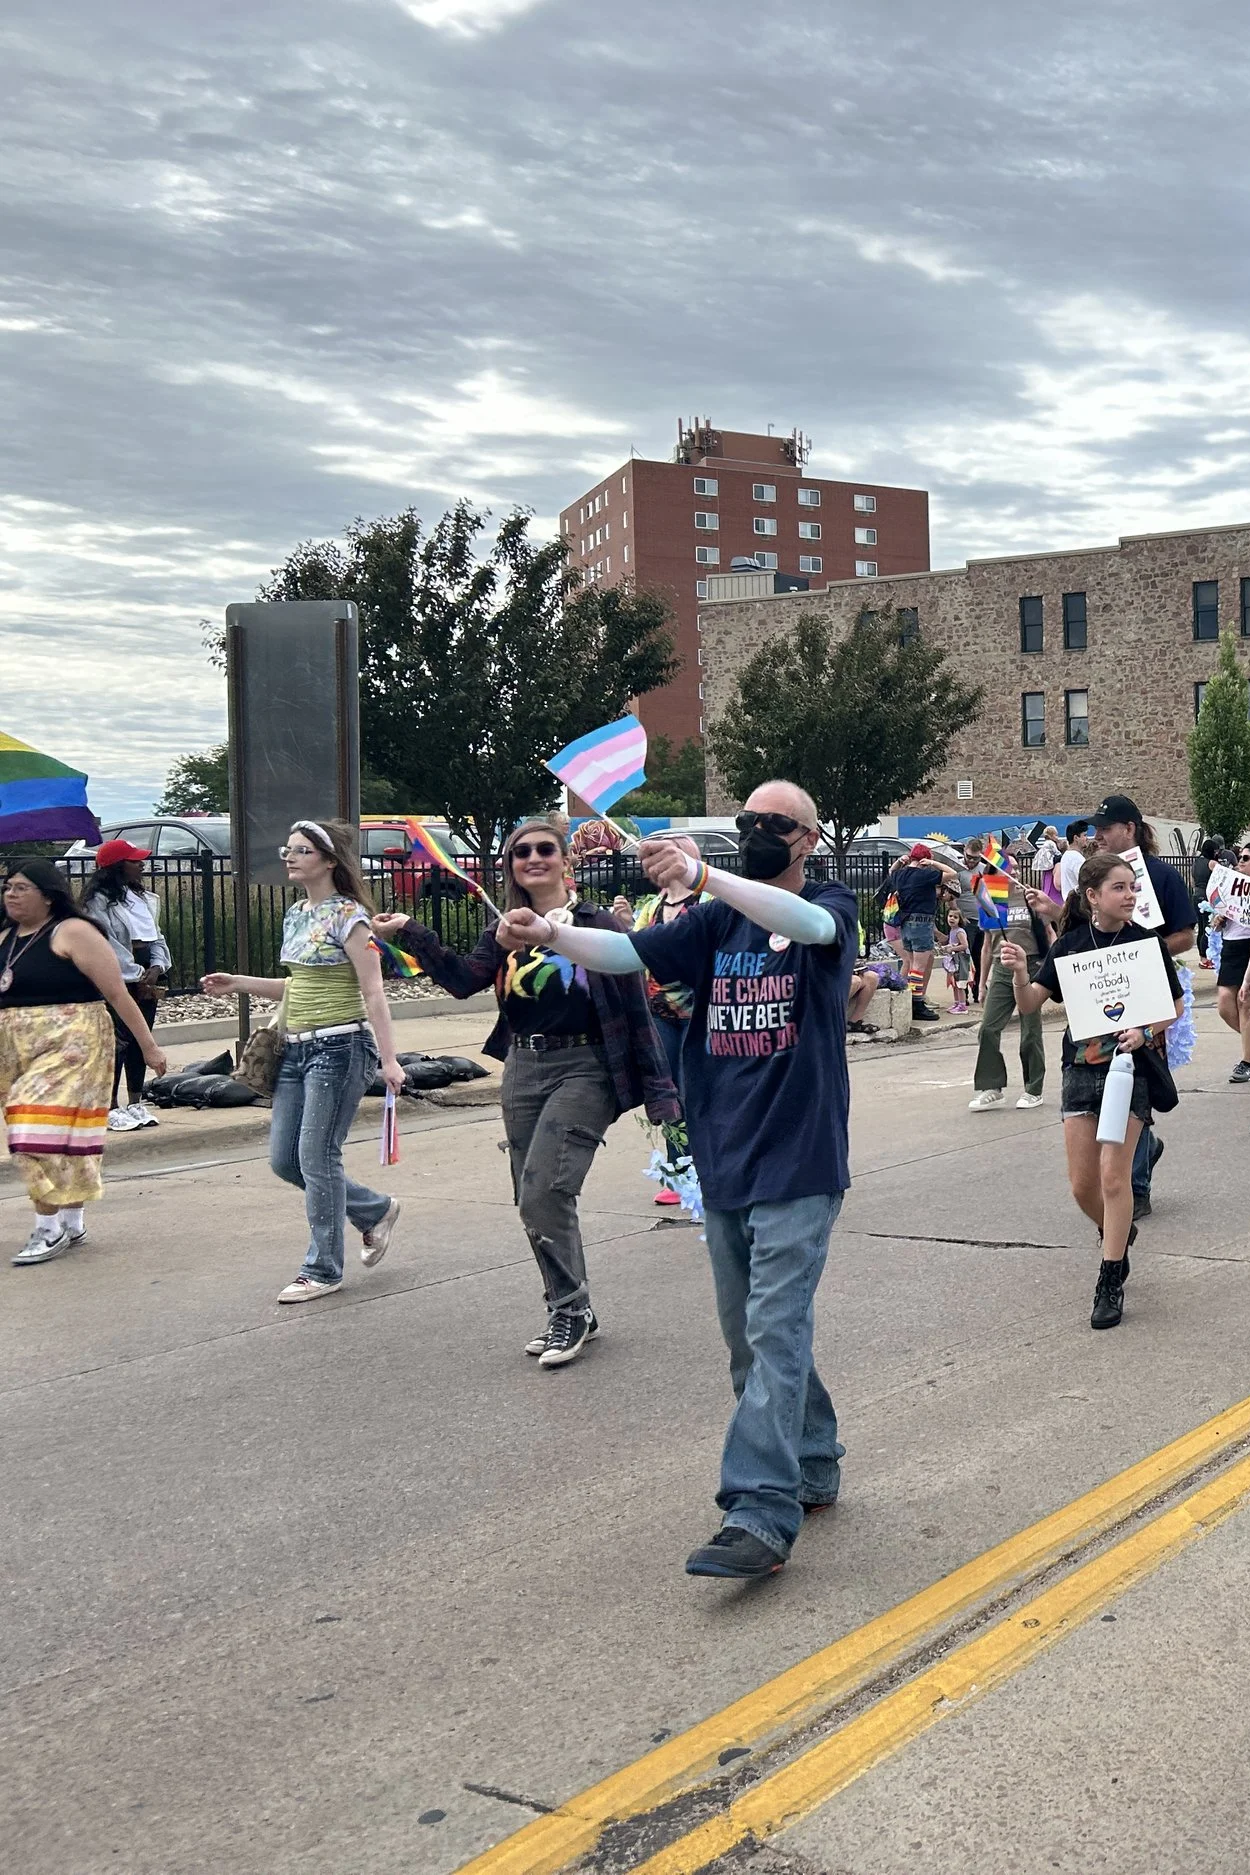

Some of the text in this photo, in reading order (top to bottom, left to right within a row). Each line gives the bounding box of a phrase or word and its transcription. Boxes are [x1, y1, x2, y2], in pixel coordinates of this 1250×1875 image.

[729, 951, 768, 977] ARE
[1072, 951, 1139, 974] Harry Potter
[712, 975, 795, 1003] HE CHANG
[1089, 973, 1130, 990] nobody
[755, 1001, 794, 1030] BEE
[710, 1032, 772, 1056] WAITING
